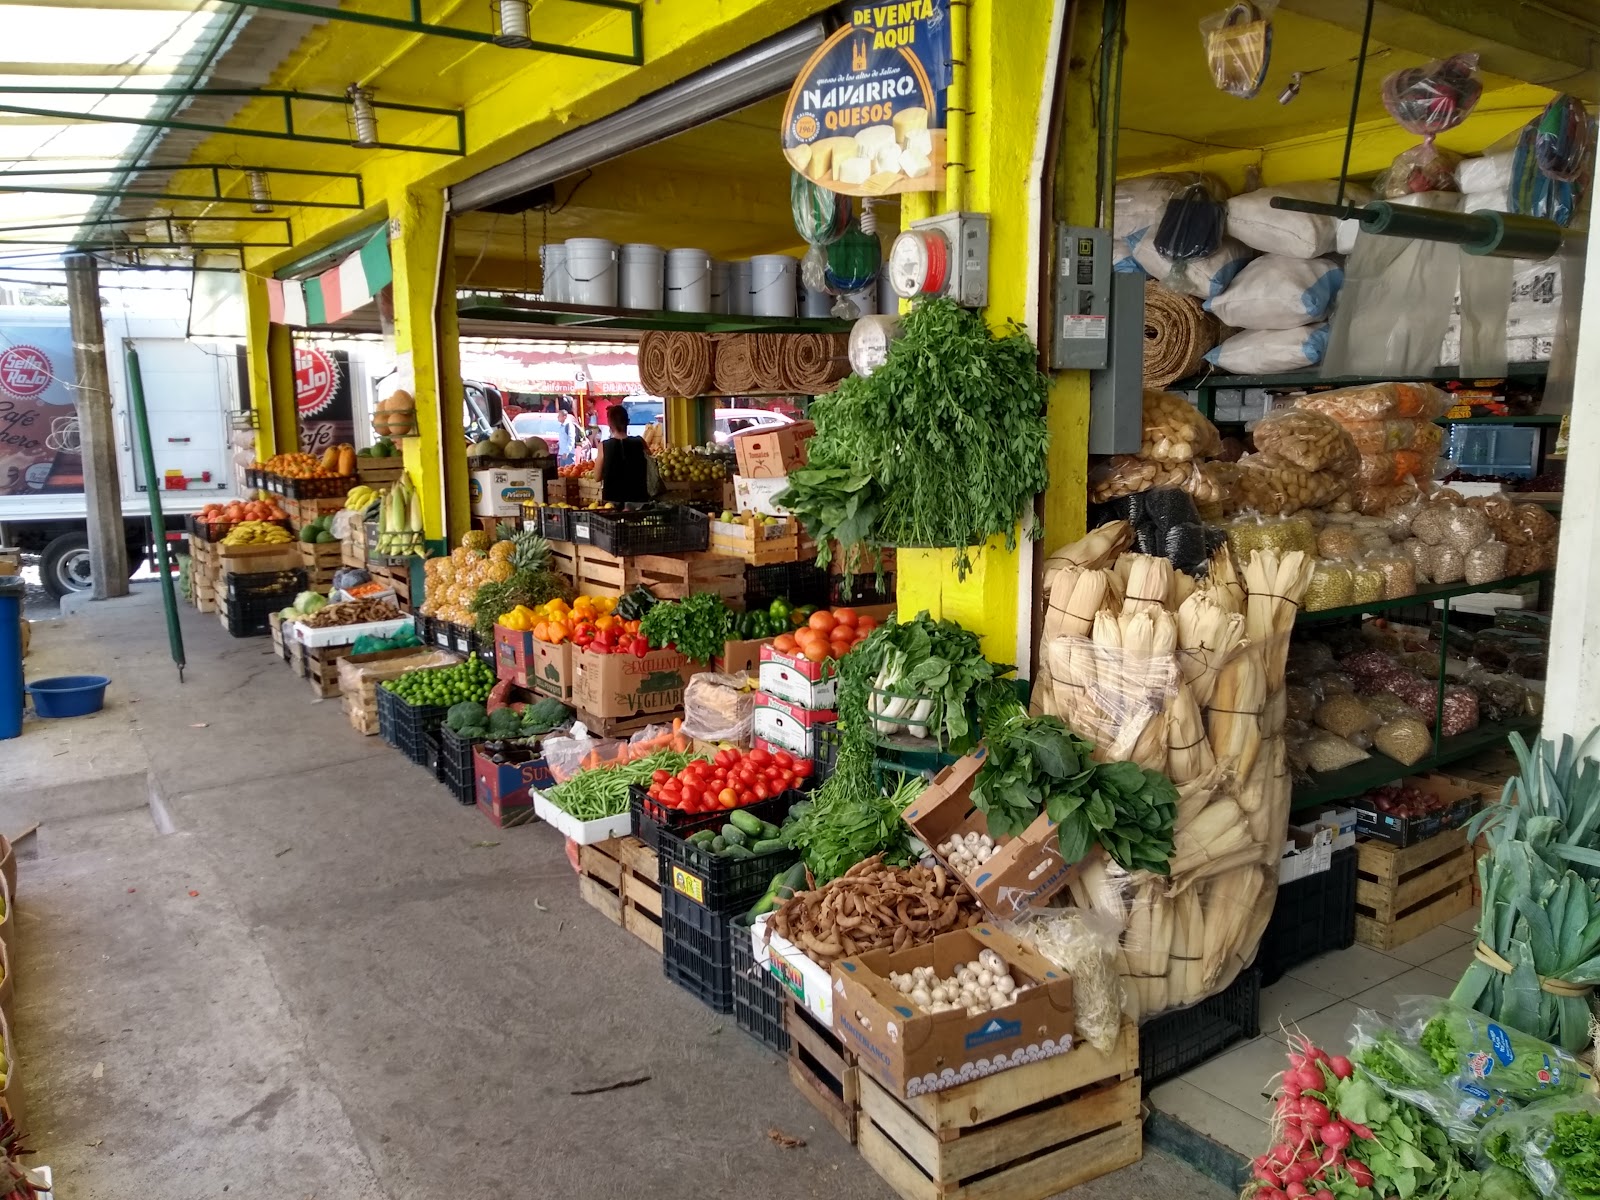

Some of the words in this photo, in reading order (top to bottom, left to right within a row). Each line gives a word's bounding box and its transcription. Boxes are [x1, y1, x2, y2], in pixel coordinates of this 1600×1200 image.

[853, 8, 871, 26] DE
[873, 0, 934, 28] VENTA
[872, 19, 915, 50] AQUÍ
[803, 75, 914, 110] NAVARRO
[825, 101, 892, 131] QUESOS
[5, 353, 43, 370] Sello
